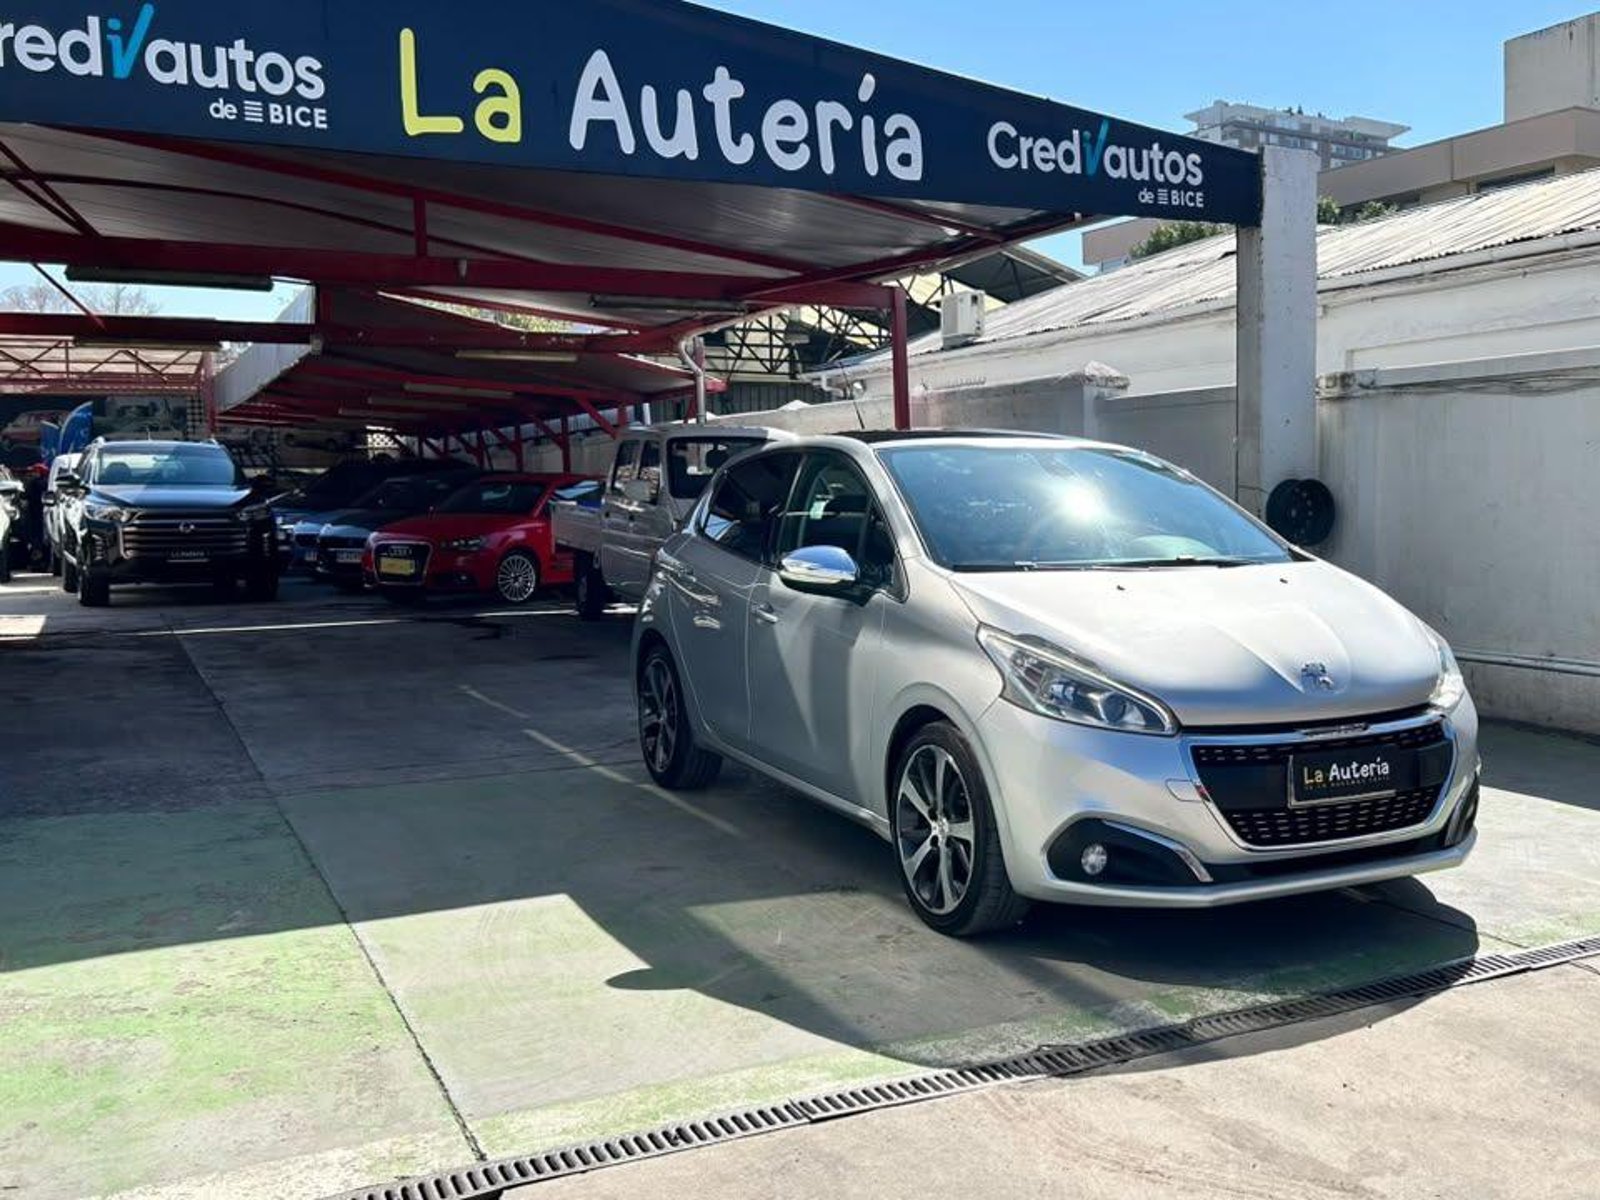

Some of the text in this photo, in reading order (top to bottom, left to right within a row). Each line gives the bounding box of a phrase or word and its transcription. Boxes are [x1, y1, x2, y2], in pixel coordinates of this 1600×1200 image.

[209, 97, 328, 129] de BICE
[400, 27, 923, 181] La Autería
[1137, 187, 1205, 208] de BICE
[1303, 766, 1324, 785] La
[1328, 756, 1389, 781] Autería
